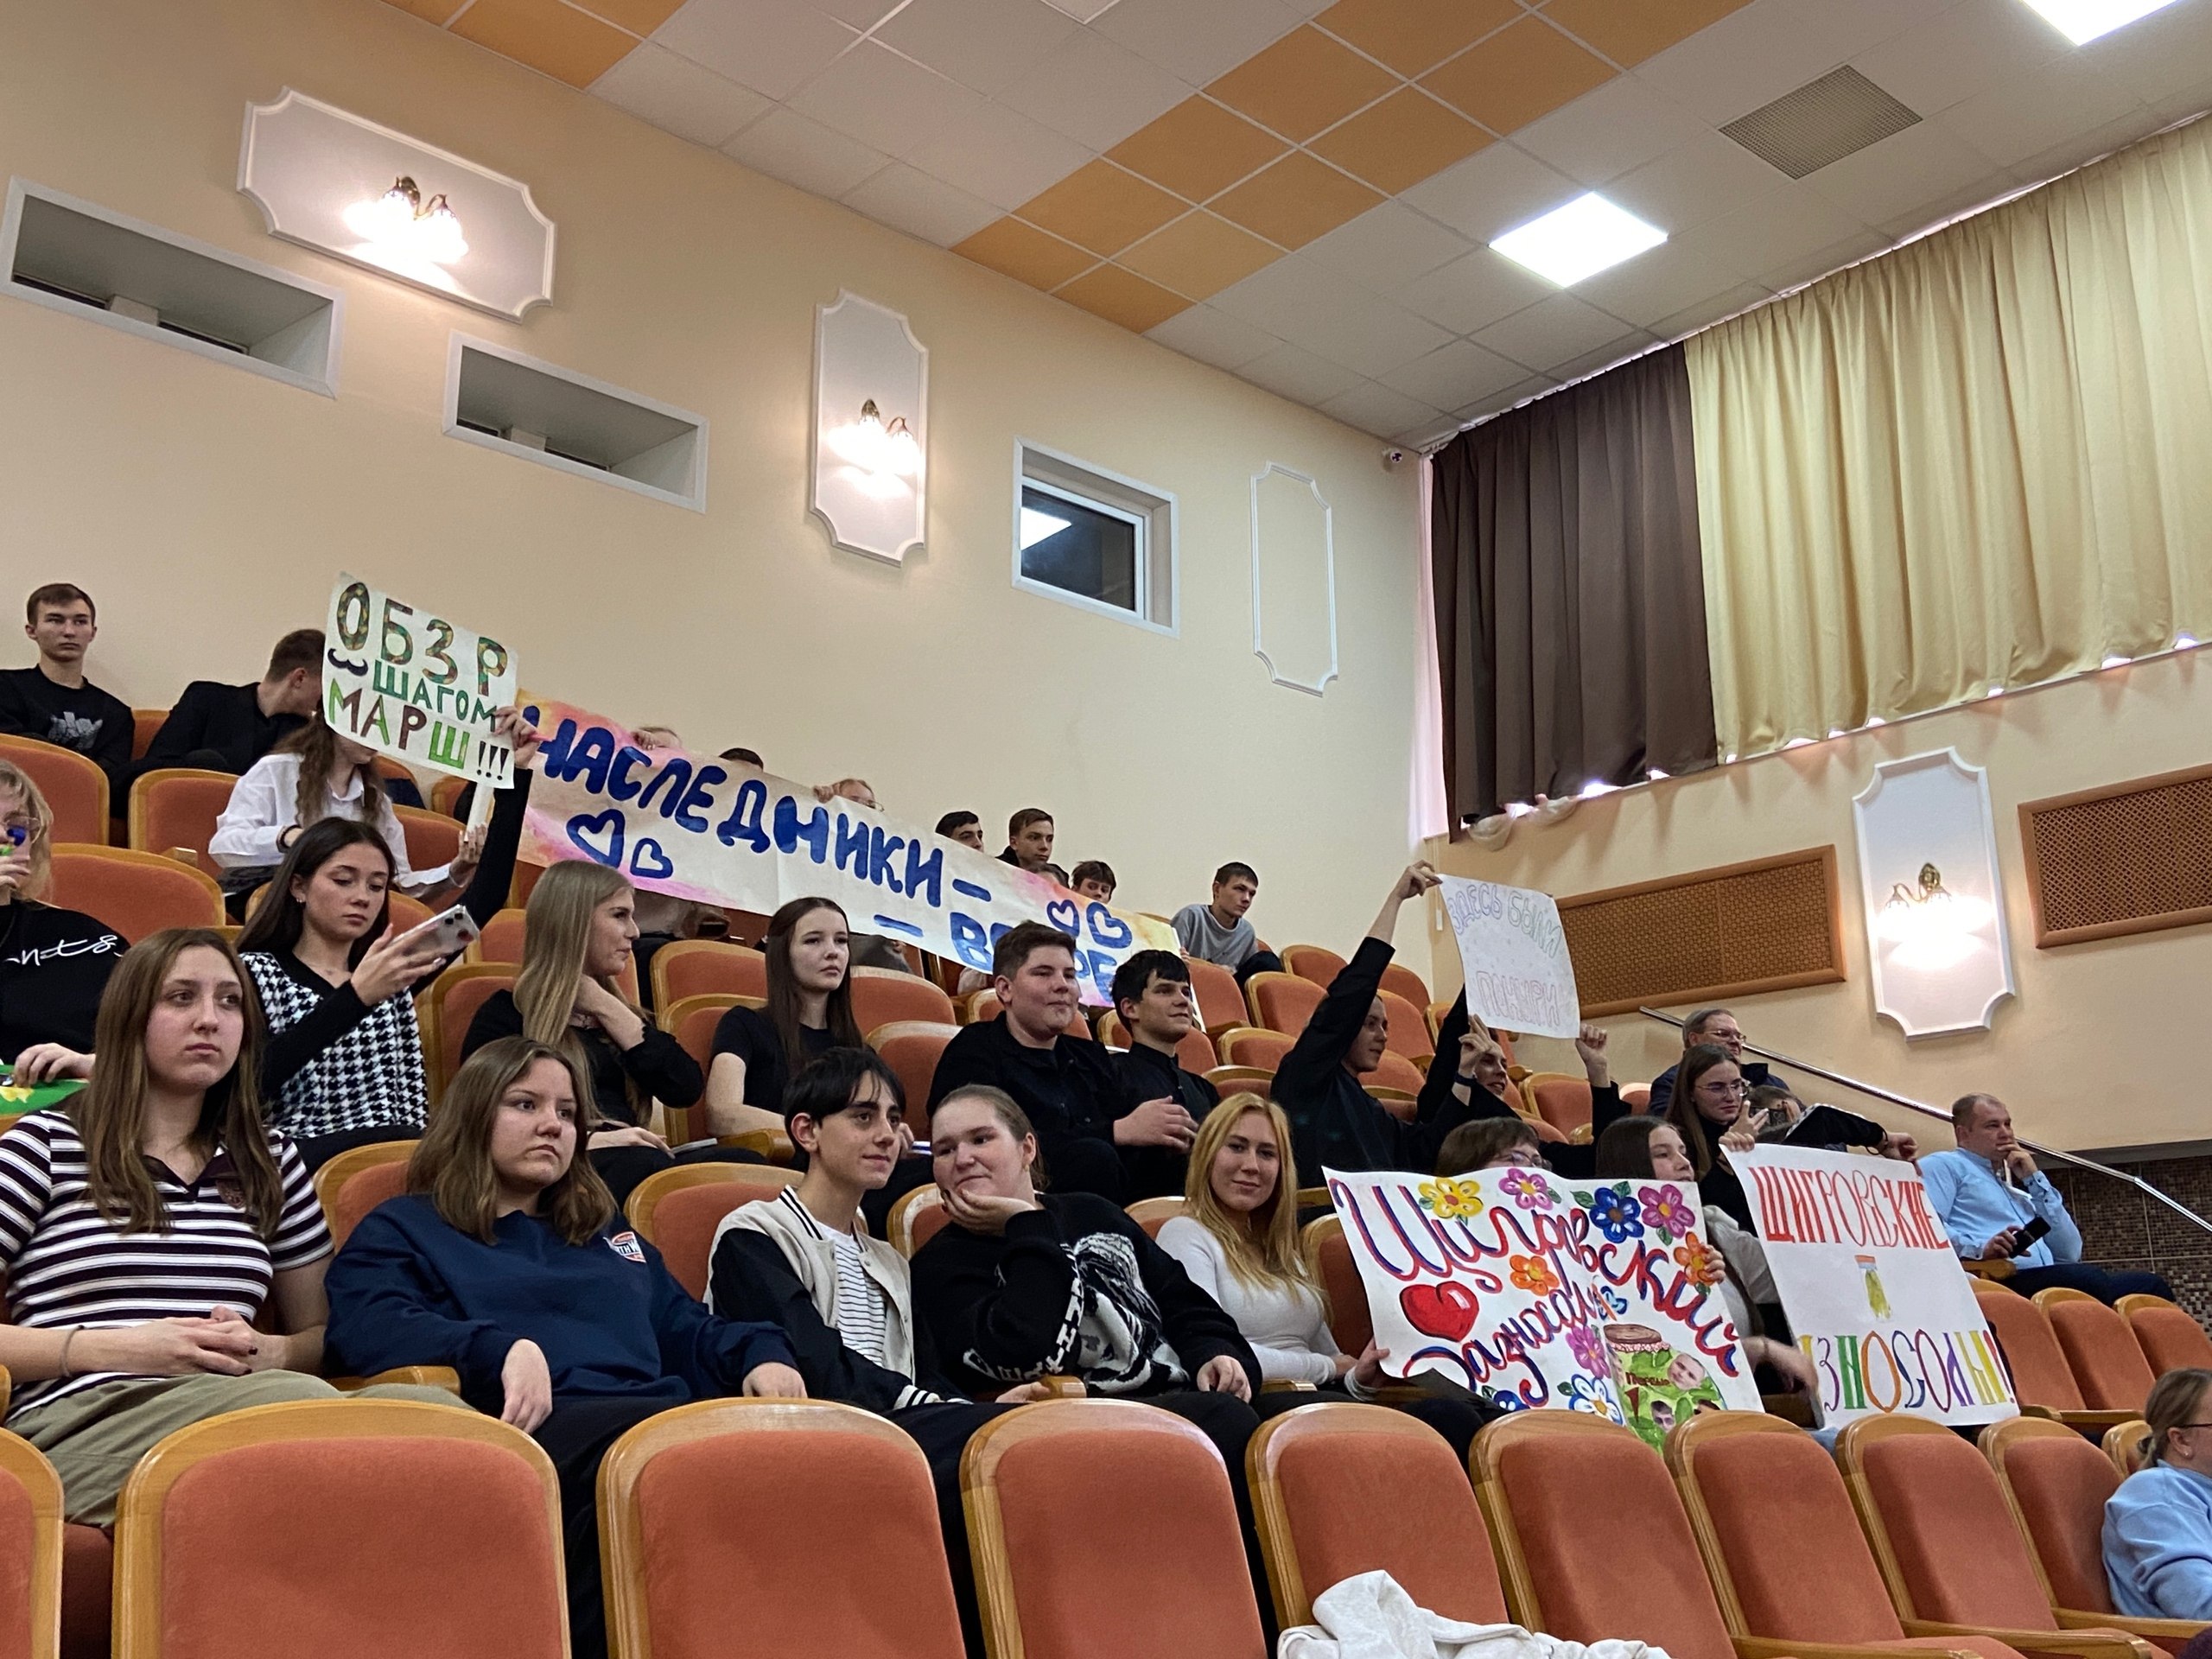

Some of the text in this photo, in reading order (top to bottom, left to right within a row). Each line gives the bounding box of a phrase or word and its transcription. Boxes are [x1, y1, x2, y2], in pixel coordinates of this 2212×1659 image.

[337, 582, 508, 697] ОБЗР
[372, 659, 498, 733] ШАГОМ
[1447, 883, 1562, 959] ЗДЕСЬ БЫЛИ
[1747, 1166, 1951, 1249] ЩИГРОВСКИЕ
